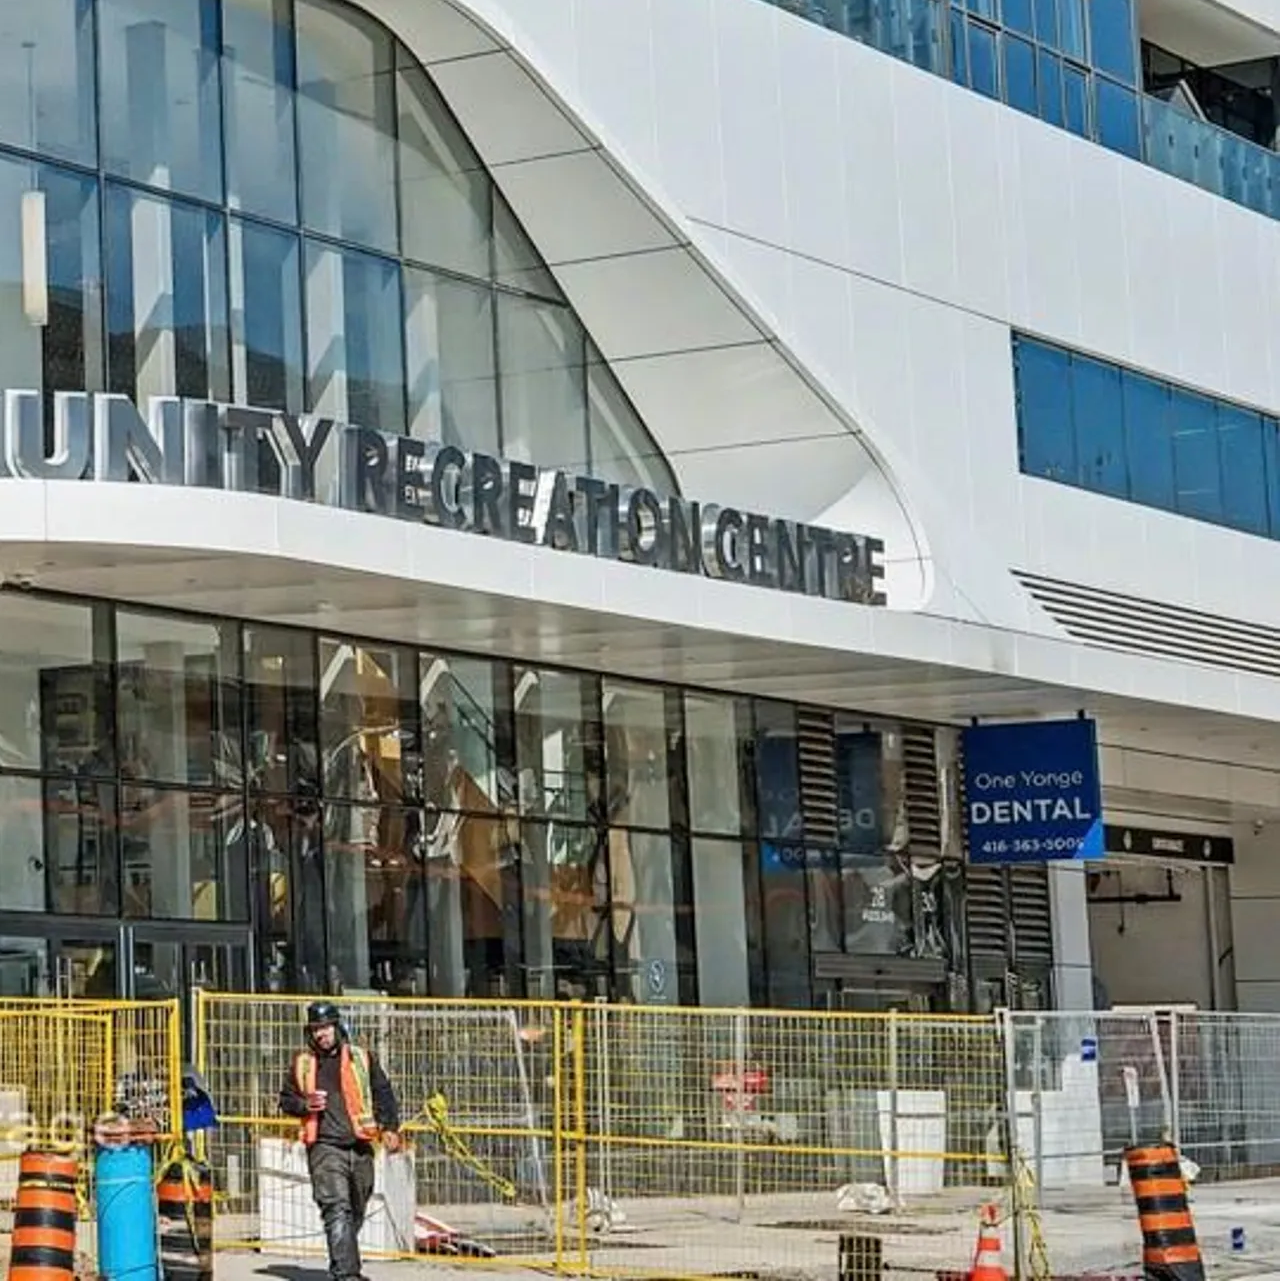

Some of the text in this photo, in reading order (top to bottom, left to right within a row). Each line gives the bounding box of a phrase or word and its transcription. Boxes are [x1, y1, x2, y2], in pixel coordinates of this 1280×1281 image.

[342, 423, 702, 576] RECREATION
[702, 503, 888, 606] CENTRE
[975, 770, 1083, 790] One Yonge
[971, 797, 1091, 824] DENTAL
